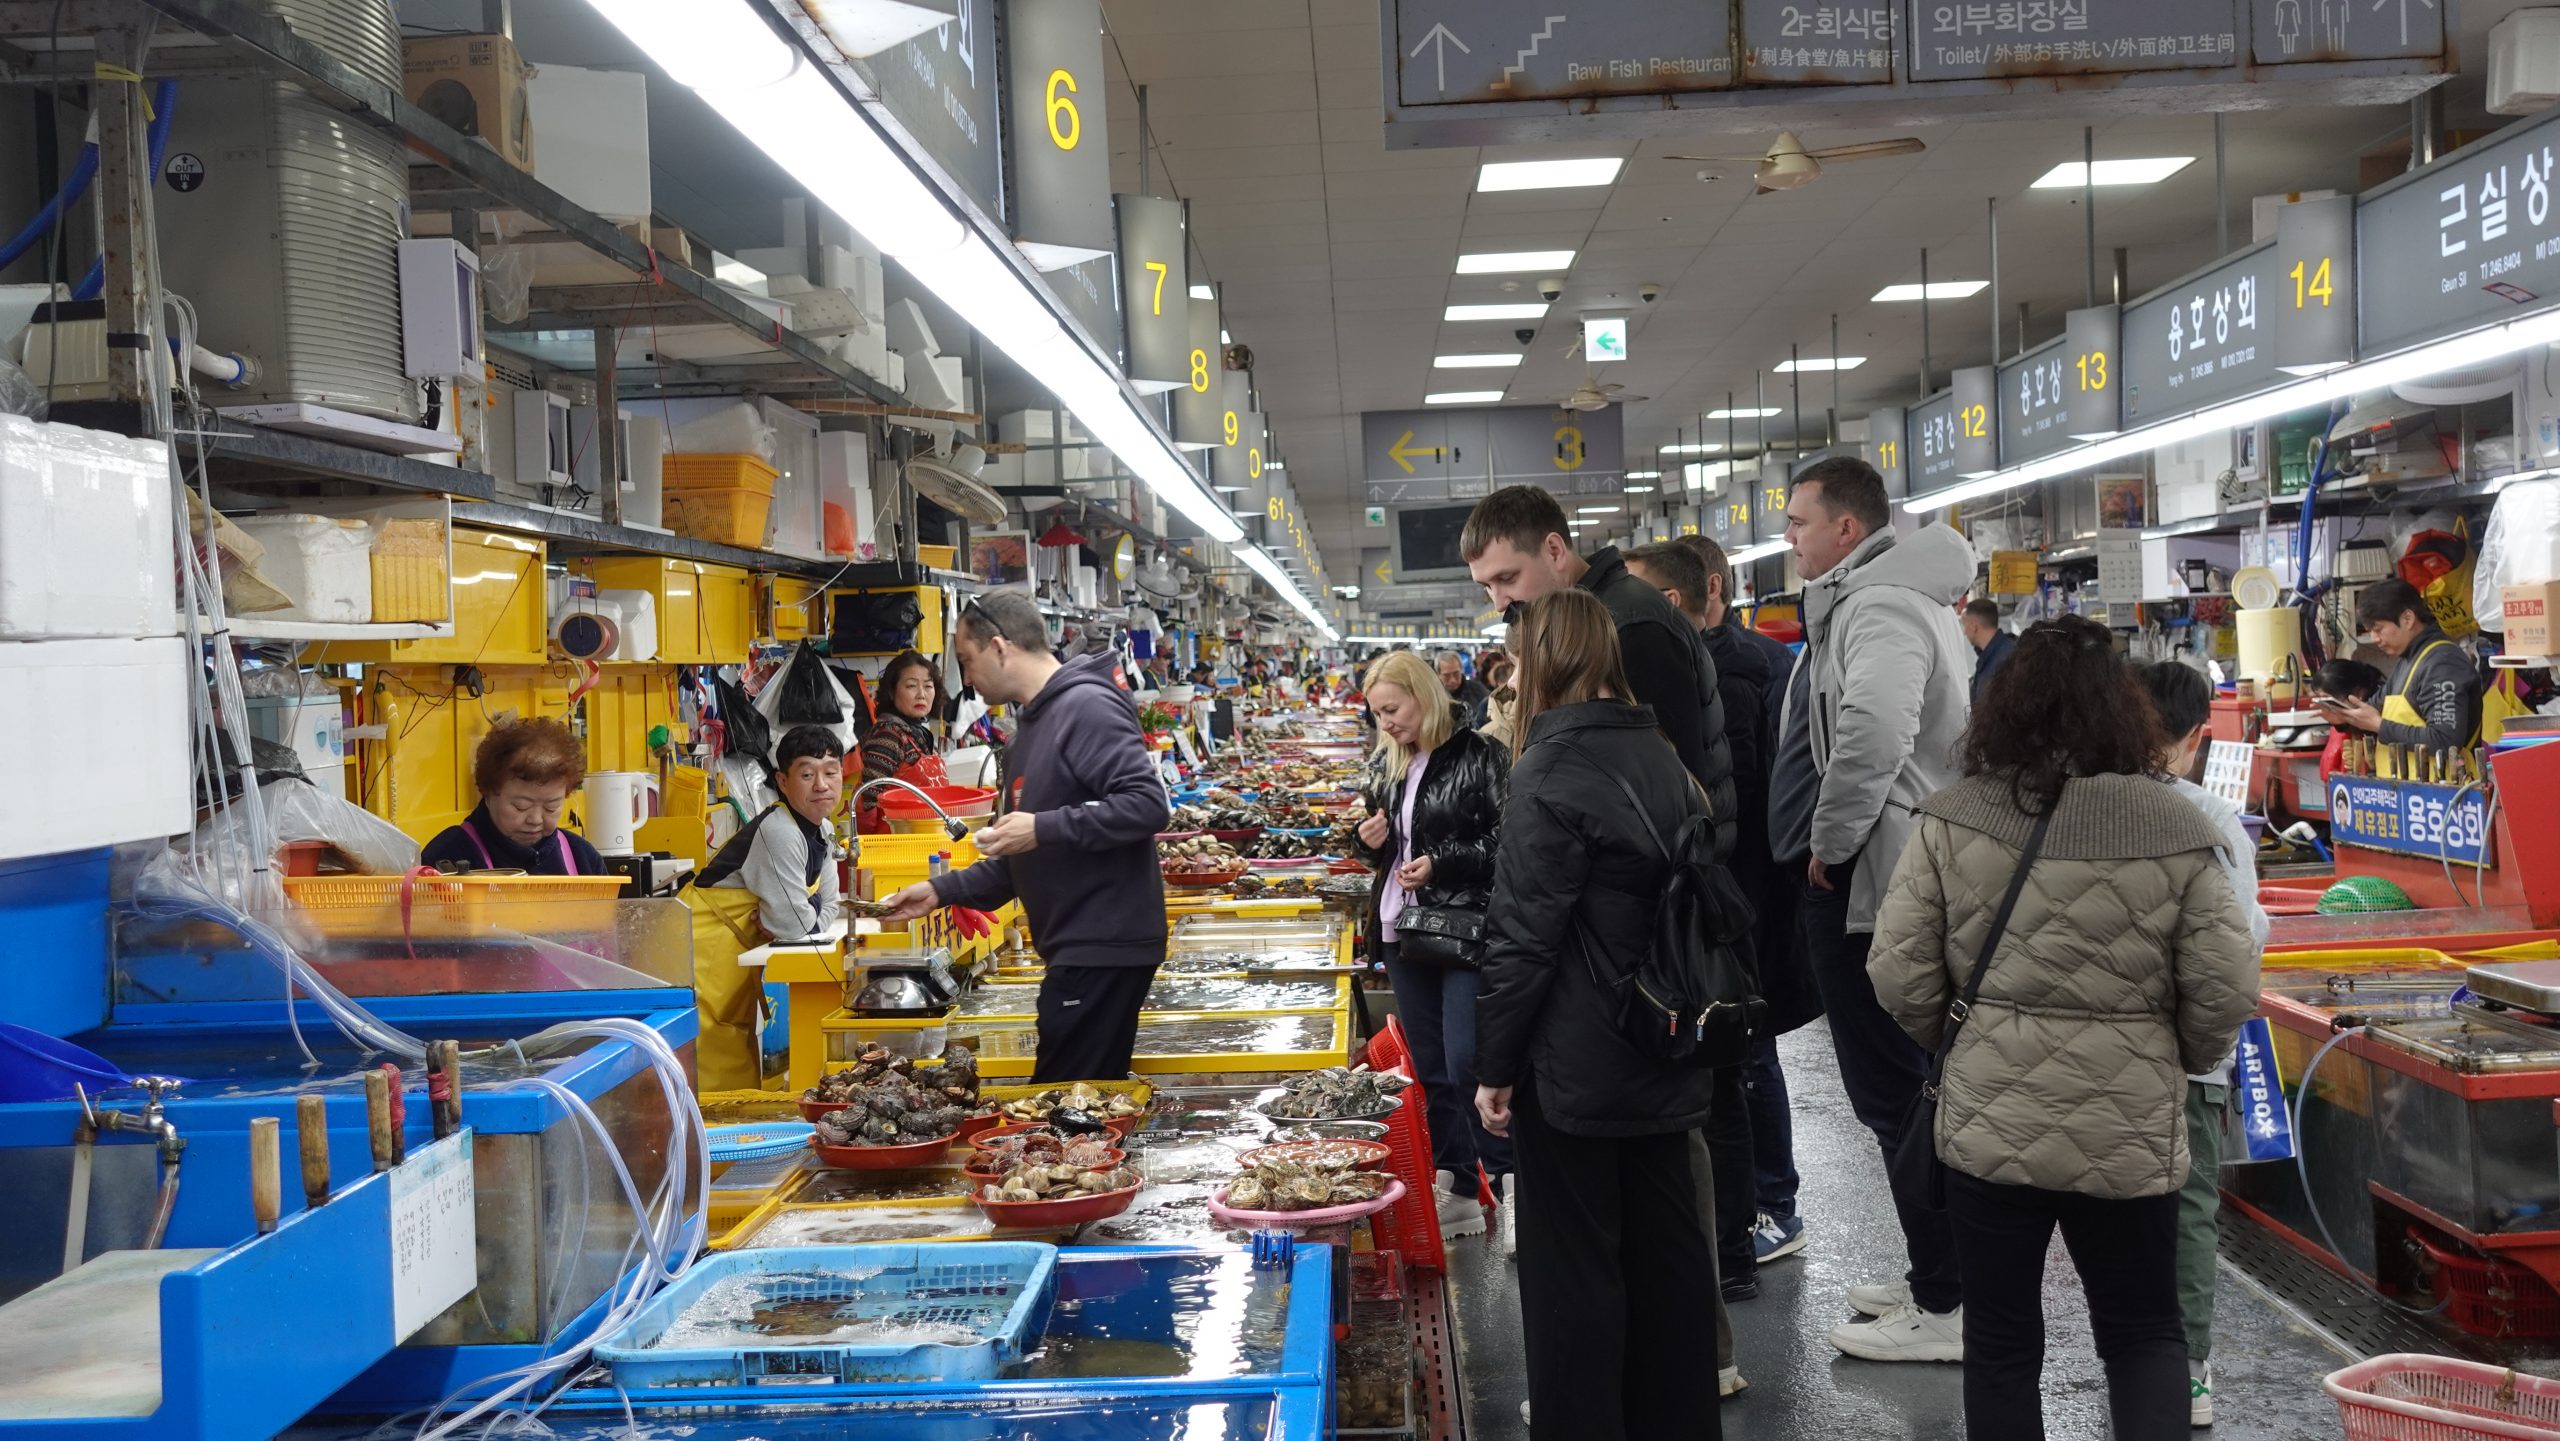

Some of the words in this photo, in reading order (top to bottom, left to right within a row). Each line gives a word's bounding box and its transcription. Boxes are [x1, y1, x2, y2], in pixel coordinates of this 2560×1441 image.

[1780, 6, 1899, 41] 2F회식당
[1933, 0, 2088, 36] 외부화장실
[1568, 63, 1602, 81] Raw
[1609, 59, 1643, 79] Fish
[1045, 68, 1081, 151] 6
[1145, 261, 1167, 316] 7
[2290, 257, 2333, 309] 14
[2168, 275, 2256, 362] 용호상회
[1190, 349, 1209, 392] 8
[2076, 351, 2107, 391] 13
[1224, 411, 1238, 446] 9
[1961, 404, 1986, 438] 12
[1553, 426, 1585, 471] 3
[1879, 441, 1896, 469] 11
[1269, 497, 1284, 521] 61
[1730, 504, 1747, 525] 74
[1766, 488, 1785, 512] 75
[2354, 809, 2399, 838] 제휴점포
[2408, 795, 2484, 848] 용호상회
